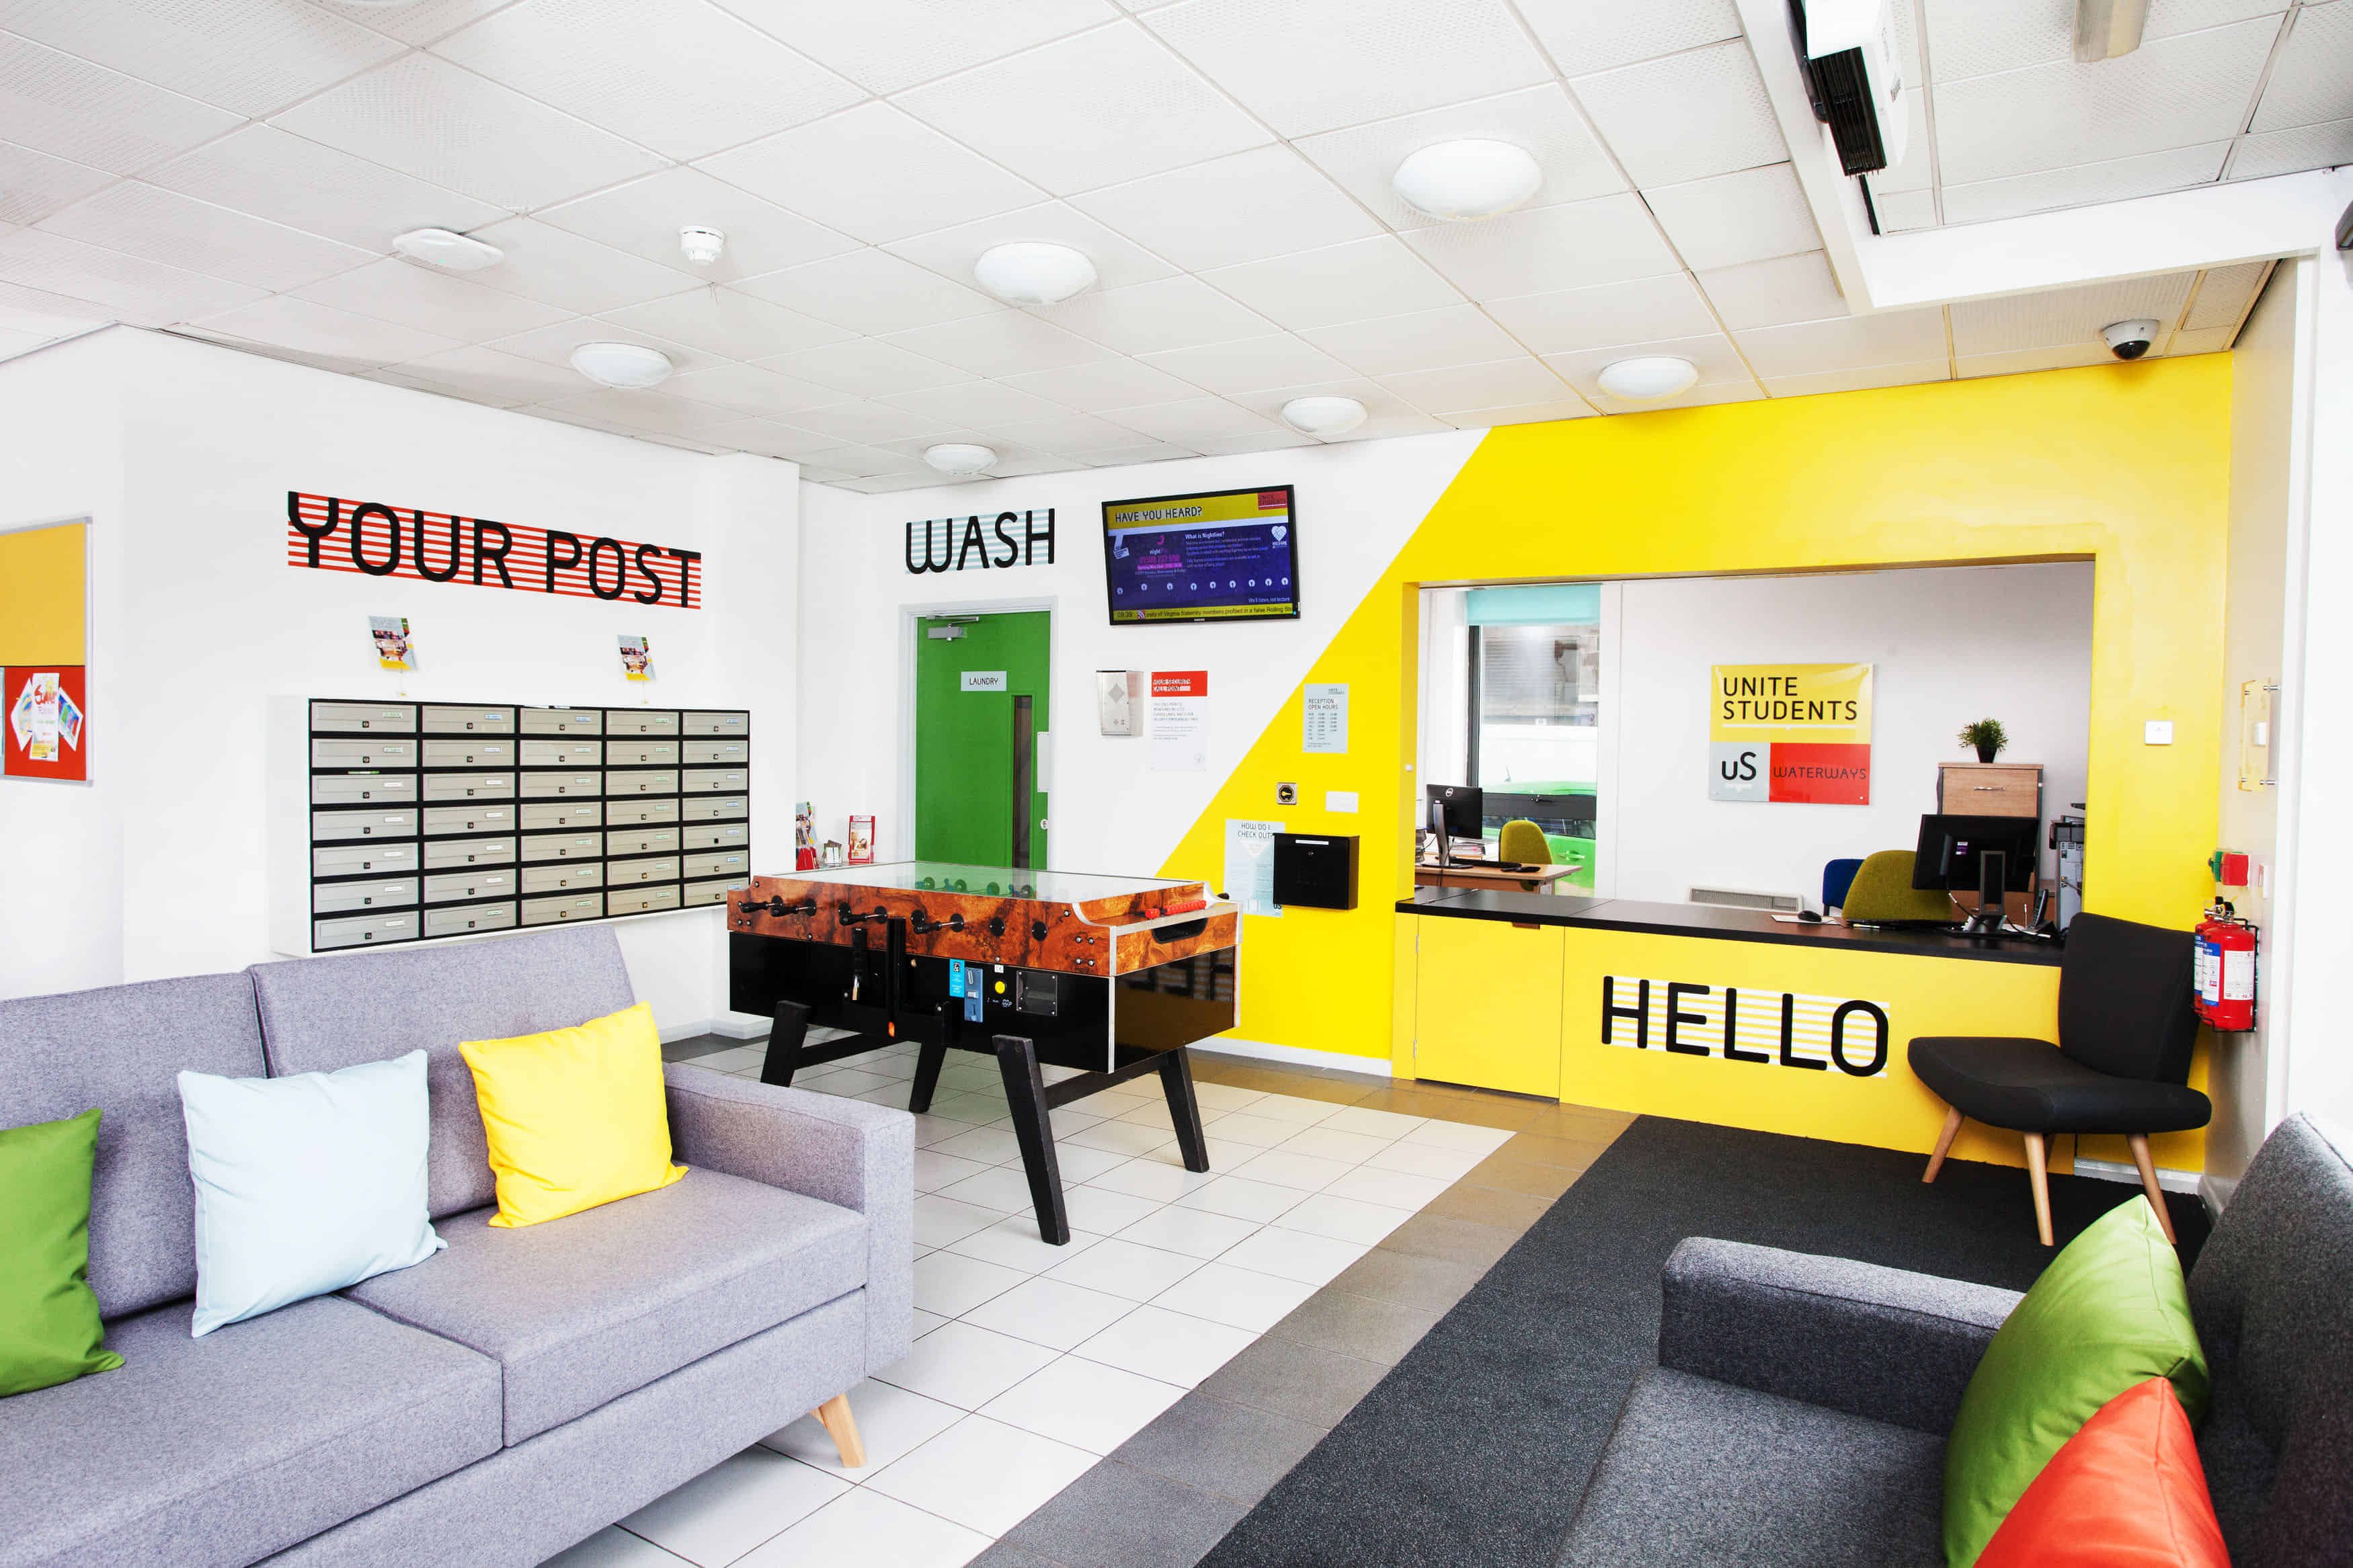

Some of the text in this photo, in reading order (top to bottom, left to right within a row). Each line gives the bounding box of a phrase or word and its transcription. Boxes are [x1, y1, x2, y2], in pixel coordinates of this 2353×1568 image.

[1115, 506, 1202, 523] HAVE YOU HEARD?
[288, 491, 701, 608] YOUR POST
[906, 508, 1055, 574] WASH
[969, 677, 999, 686] LAUNDRY
[1722, 677, 1798, 696] UNITE
[1722, 701, 1858, 720] STUDENTS
[1773, 767, 1868, 780] WATERWAYS
[1601, 975, 1889, 1077] HELLO
